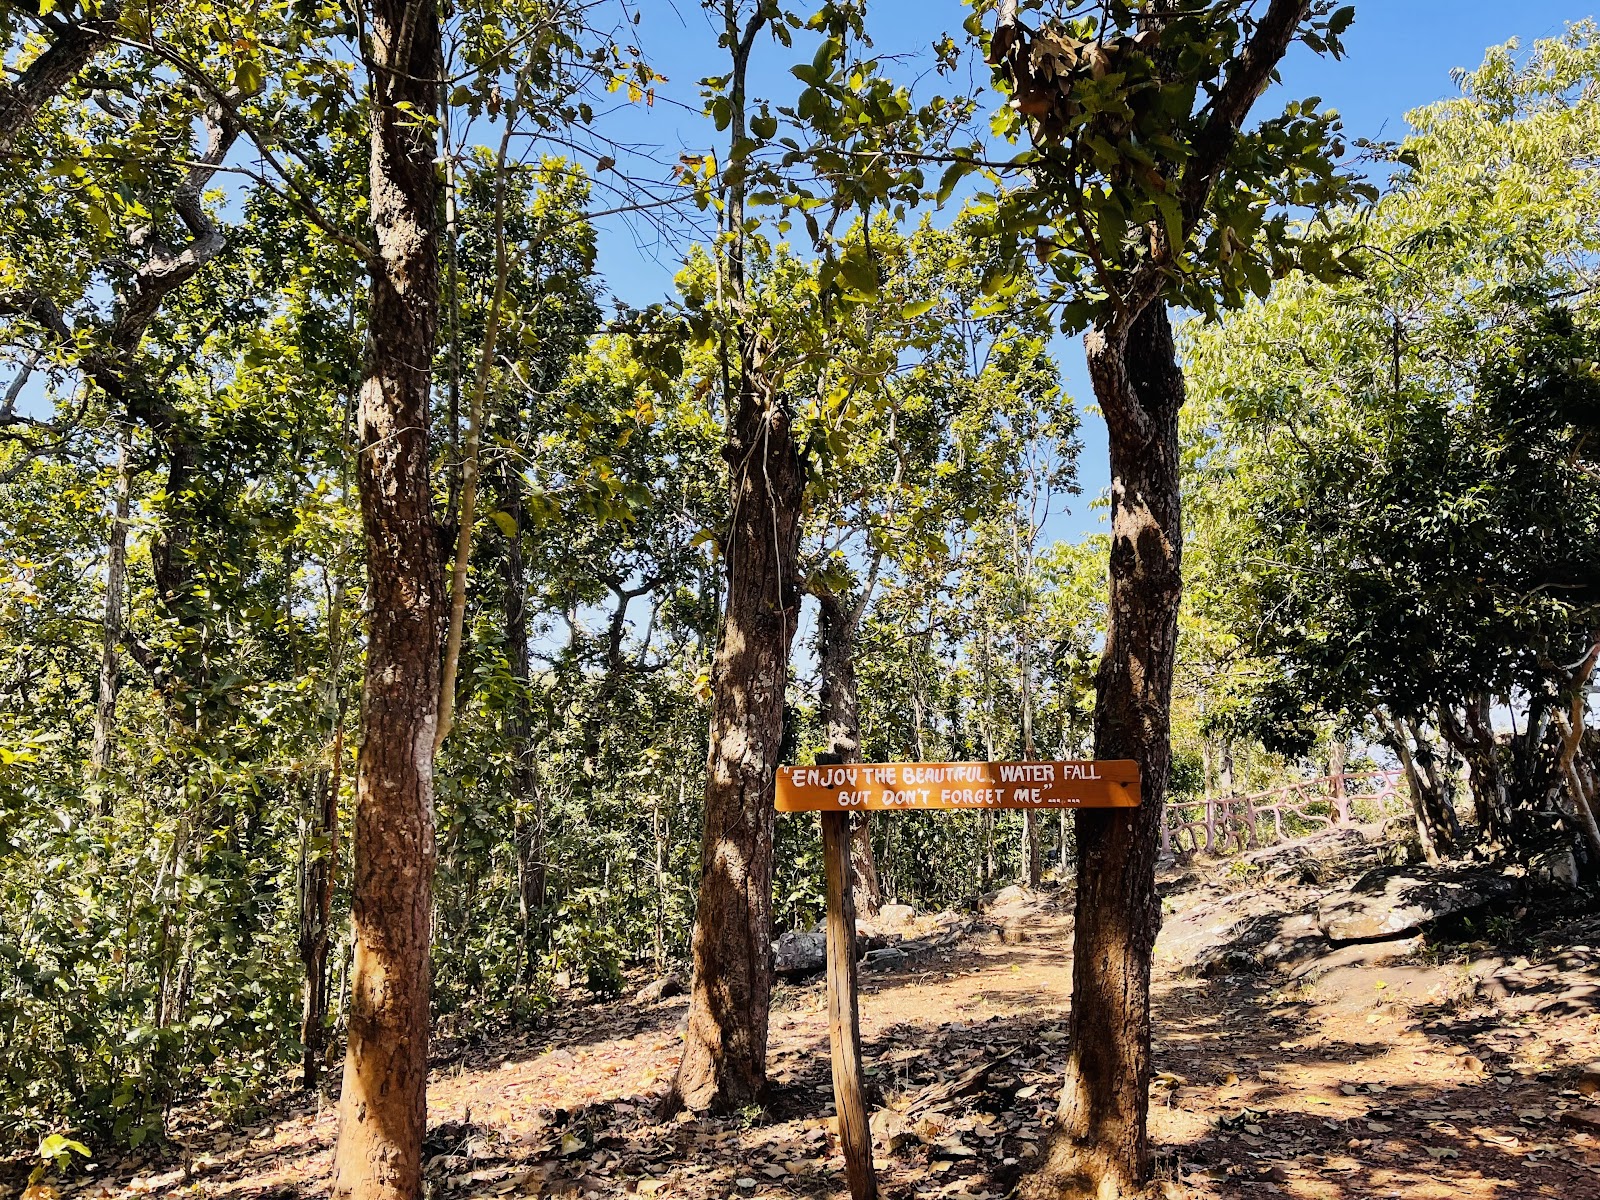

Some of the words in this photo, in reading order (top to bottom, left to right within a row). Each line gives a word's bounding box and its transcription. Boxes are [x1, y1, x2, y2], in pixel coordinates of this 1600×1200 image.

[862, 767, 897, 785] THE
[1000, 764, 1055, 782] WATER
[1063, 764, 1102, 780] FALL
[837, 789, 871, 806] BUT
[881, 788, 931, 806] DON'T
[940, 788, 1006, 805] FORGET
